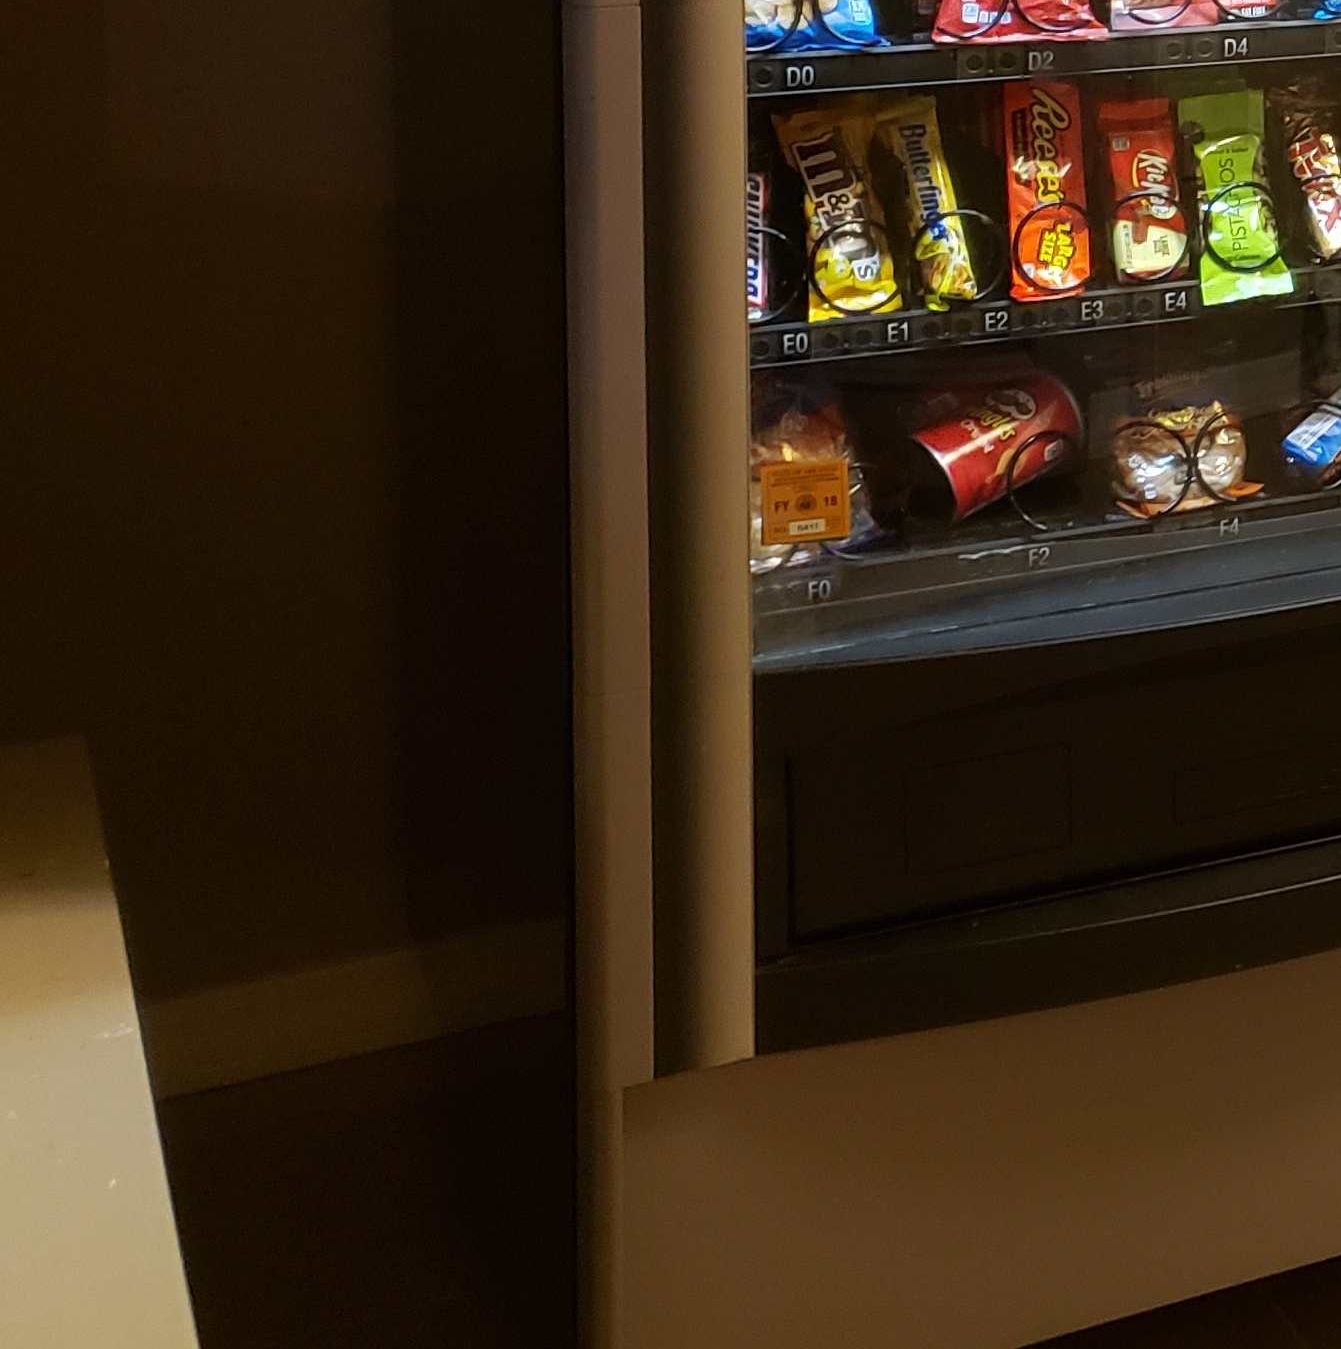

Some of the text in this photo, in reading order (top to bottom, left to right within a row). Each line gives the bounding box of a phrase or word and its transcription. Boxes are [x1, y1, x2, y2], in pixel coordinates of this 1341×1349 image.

[1224, 37, 1249, 58] D4
[1028, 51, 1055, 72] D2
[786, 66, 815, 88] D0
[1037, 228, 1057, 264] SIZE
[1081, 300, 1105, 321] E3
[1165, 292, 1188, 313] E4
[886, 322, 910, 344] E1
[984, 312, 1010, 333] E2
[783, 333, 809, 354] E0
[774, 500, 790, 514] FY
[1219, 517, 1241, 537] F4
[1028, 547, 1051, 568] F2
[808, 580, 832, 602] F0
